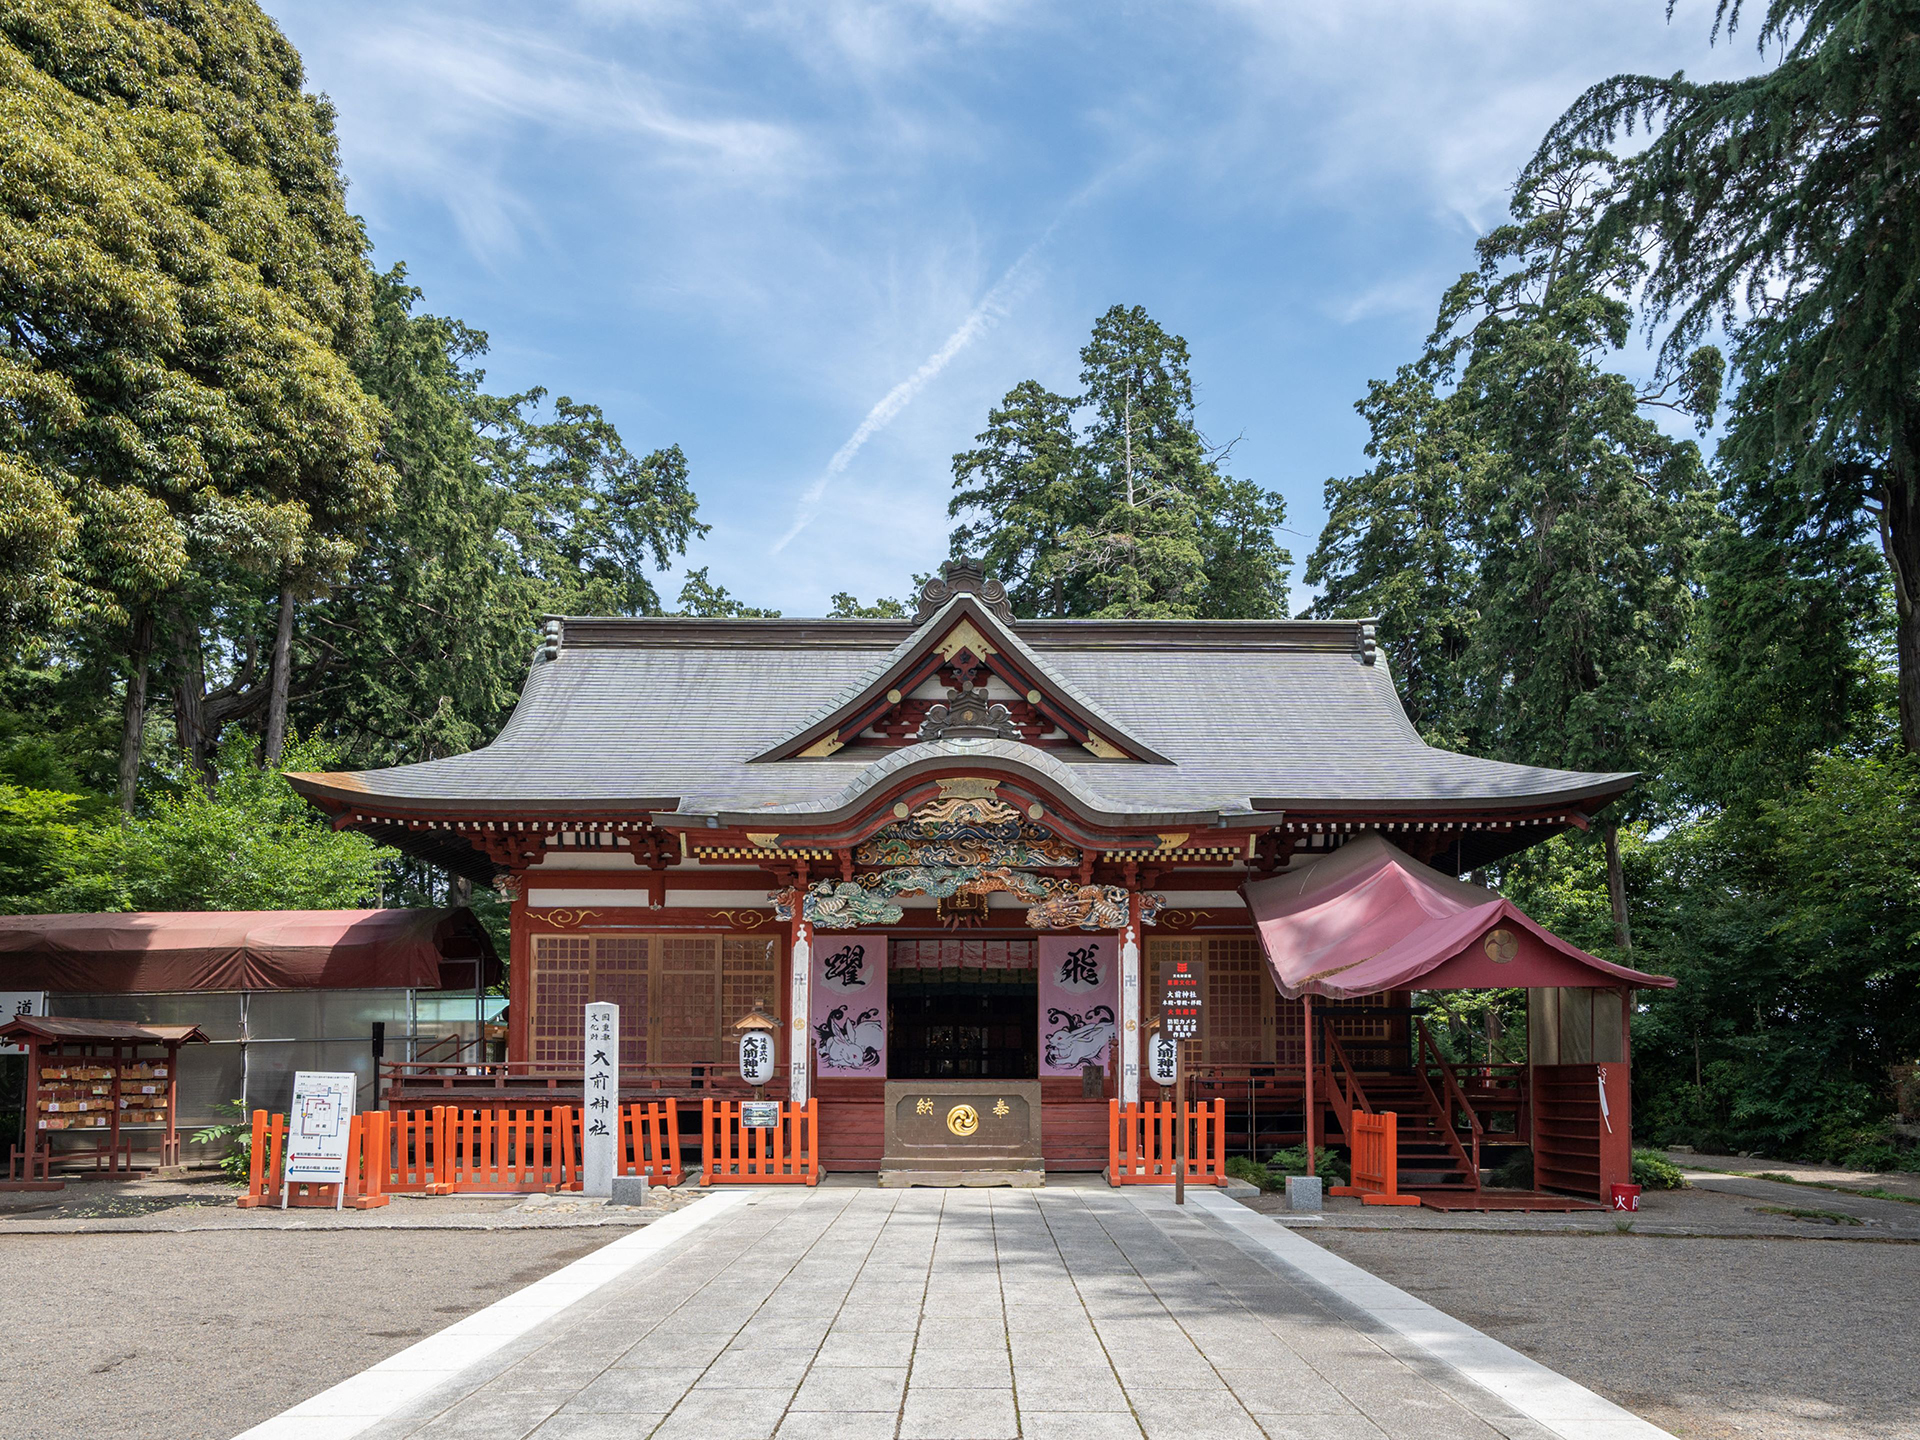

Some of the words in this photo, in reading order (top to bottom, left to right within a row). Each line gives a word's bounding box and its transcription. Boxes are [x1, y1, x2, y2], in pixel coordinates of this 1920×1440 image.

[1060, 943, 1100, 986] 飛
[1167, 990, 1197, 998] 大前神社
[743, 1036, 759, 1079] 大前神社
[1157, 1039, 1174, 1078] 大前神社
[589, 1050, 610, 1136] 大前神社
[916, 1097, 934, 1115] 納
[992, 1097, 1010, 1119] 奉
